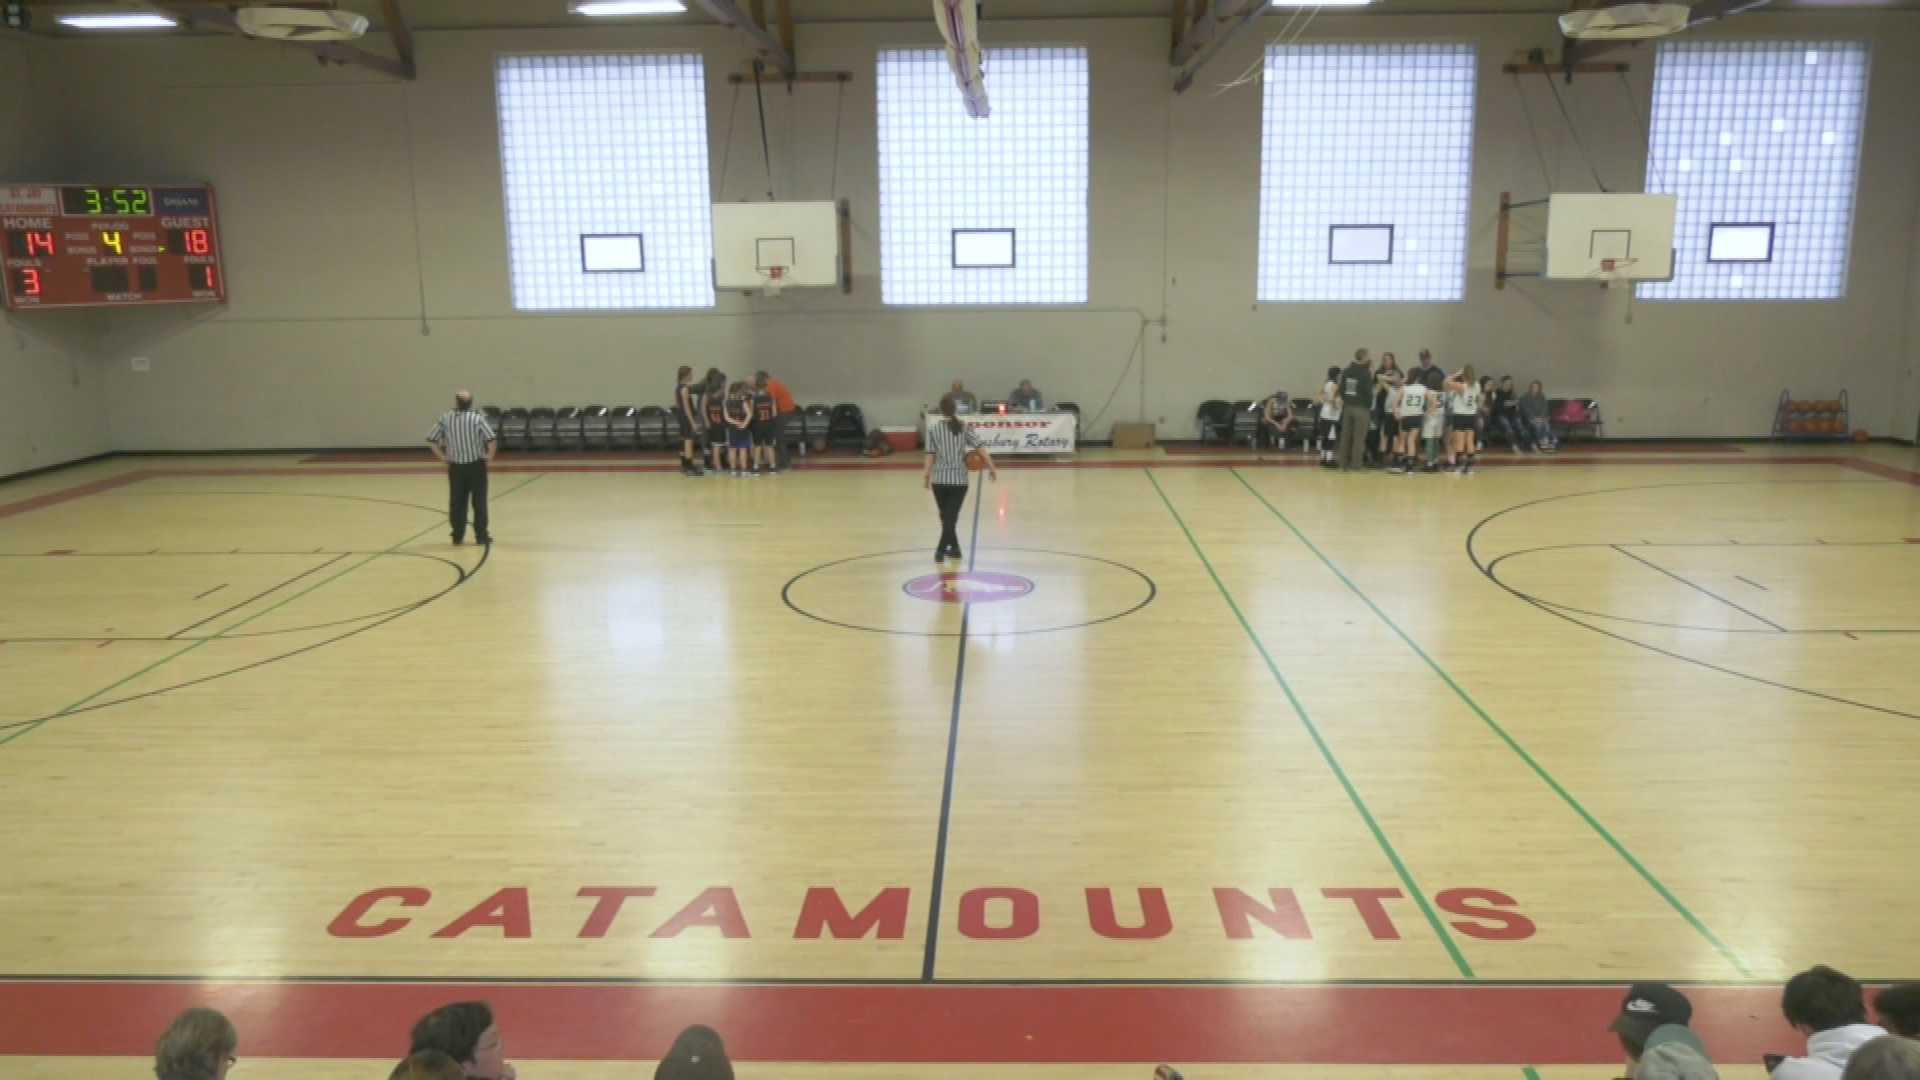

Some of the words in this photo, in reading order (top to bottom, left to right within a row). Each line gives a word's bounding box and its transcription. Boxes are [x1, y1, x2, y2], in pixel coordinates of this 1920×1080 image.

[84, 189, 147, 213] 3:52
[3, 217, 53, 229] HOME
[160, 217, 210, 228] GUEST
[26, 231, 54, 255] 14
[102, 231, 122, 255] 4
[184, 230, 209, 253] 18
[7, 258, 42, 267] FOULS
[21, 269, 40, 294] 3
[205, 265, 213, 287] 1
[106, 293, 142, 301] MATCH
[1405, 394, 1422, 407] 23
[1024, 433, 1070, 449] Rotary
[326, 886, 1537, 941] CATAMOUNTS
